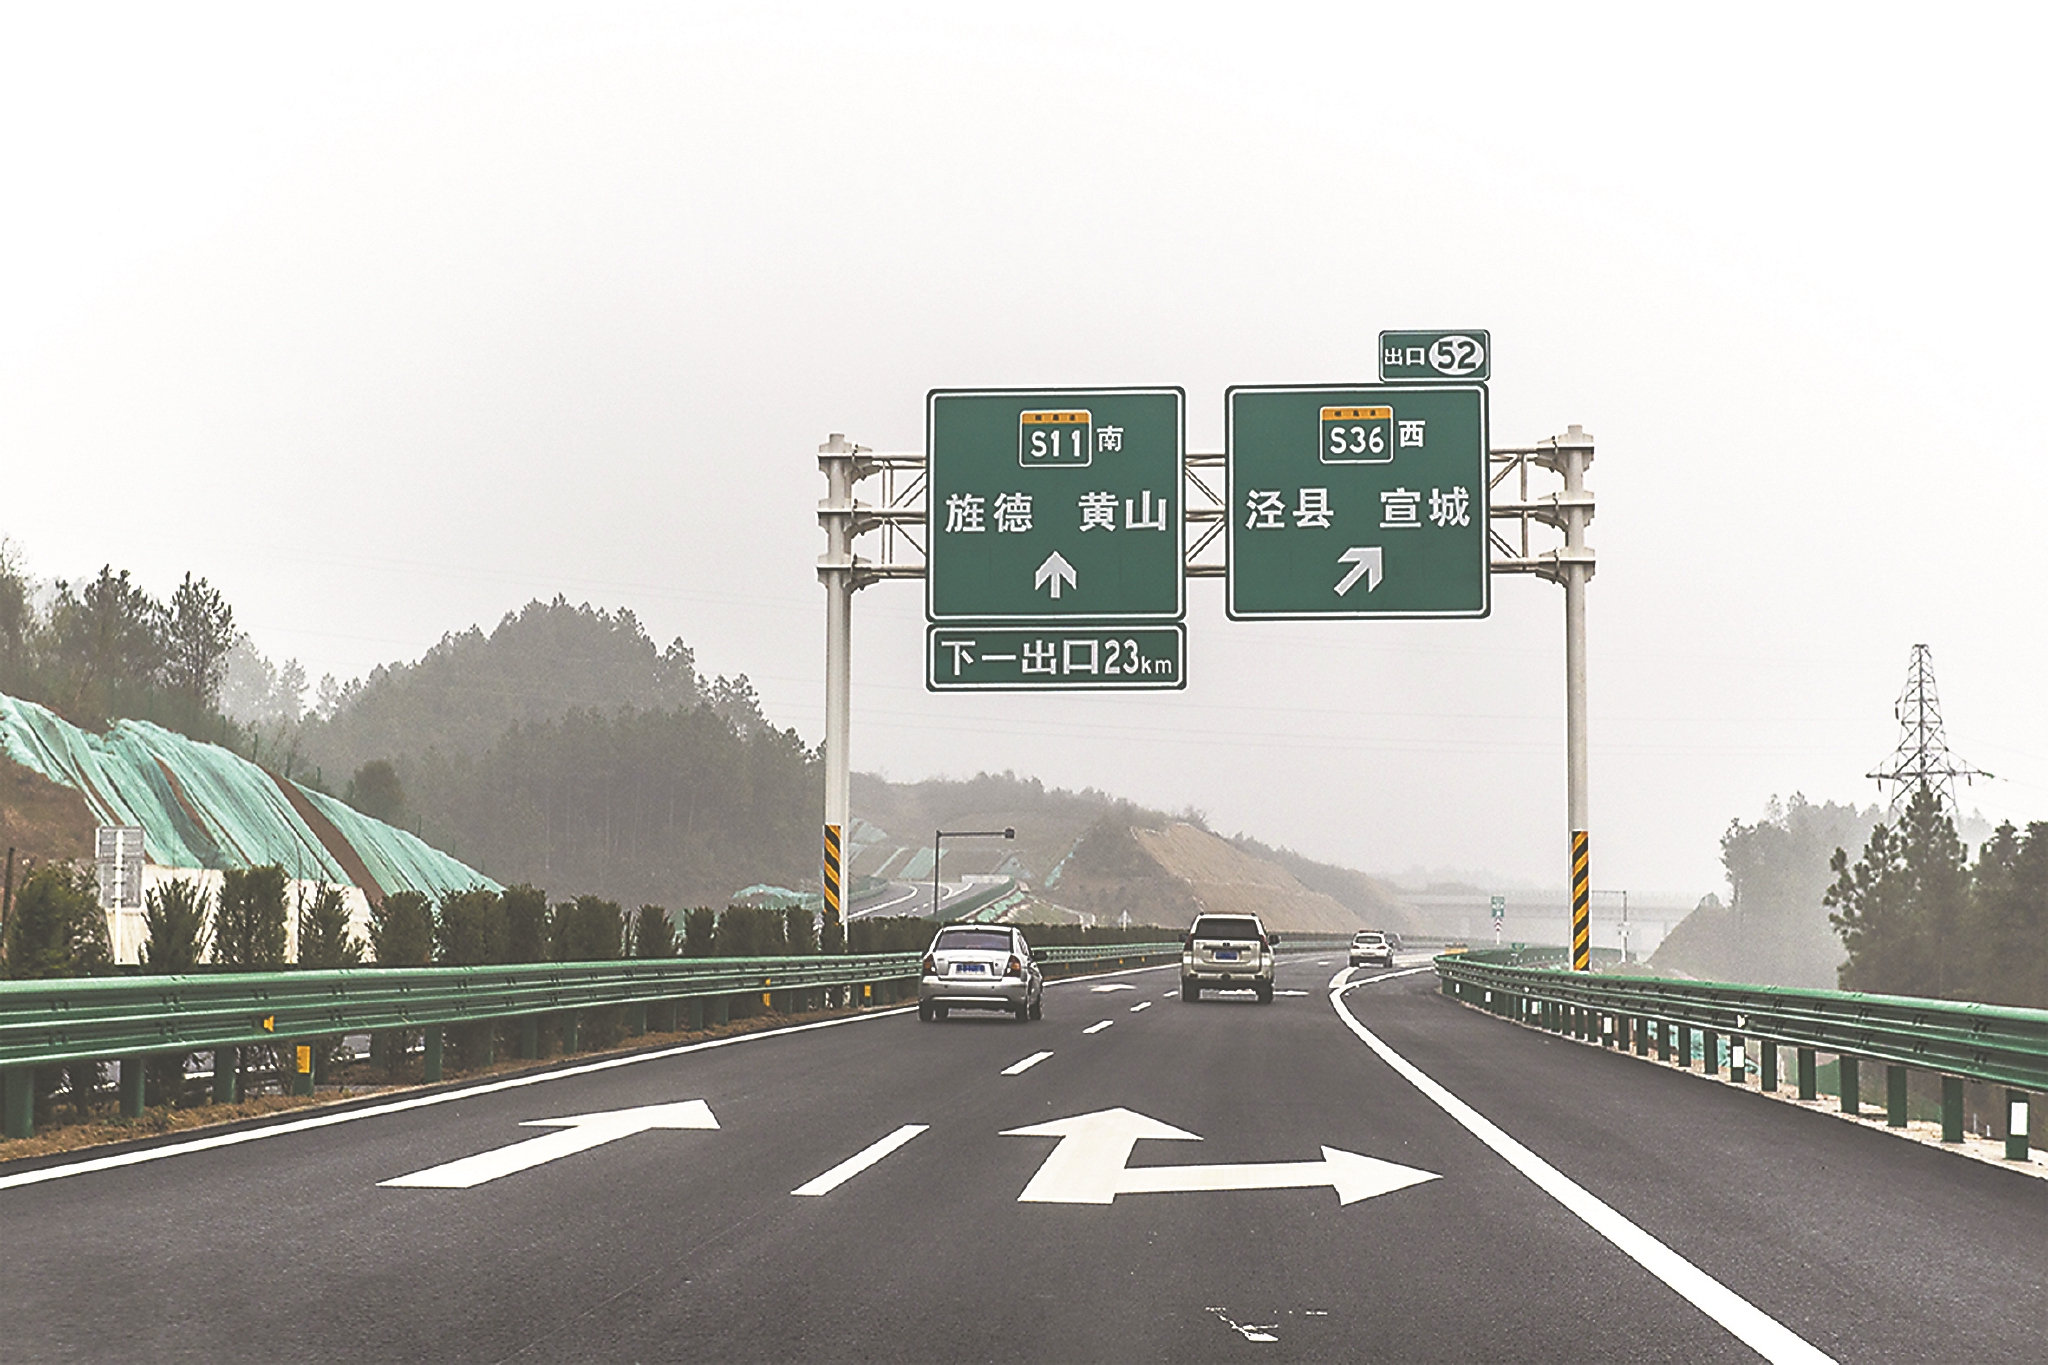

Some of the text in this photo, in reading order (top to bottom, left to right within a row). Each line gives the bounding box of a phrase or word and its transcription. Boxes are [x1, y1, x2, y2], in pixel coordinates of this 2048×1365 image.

[1384, 340, 1477, 369] 出口 52
[1030, 425, 1124, 457] S11 南
[1330, 420, 1426, 454] S36 西
[945, 490, 1168, 533] 旌德 黄山
[1245, 486, 1471, 530] 泾县 宣城
